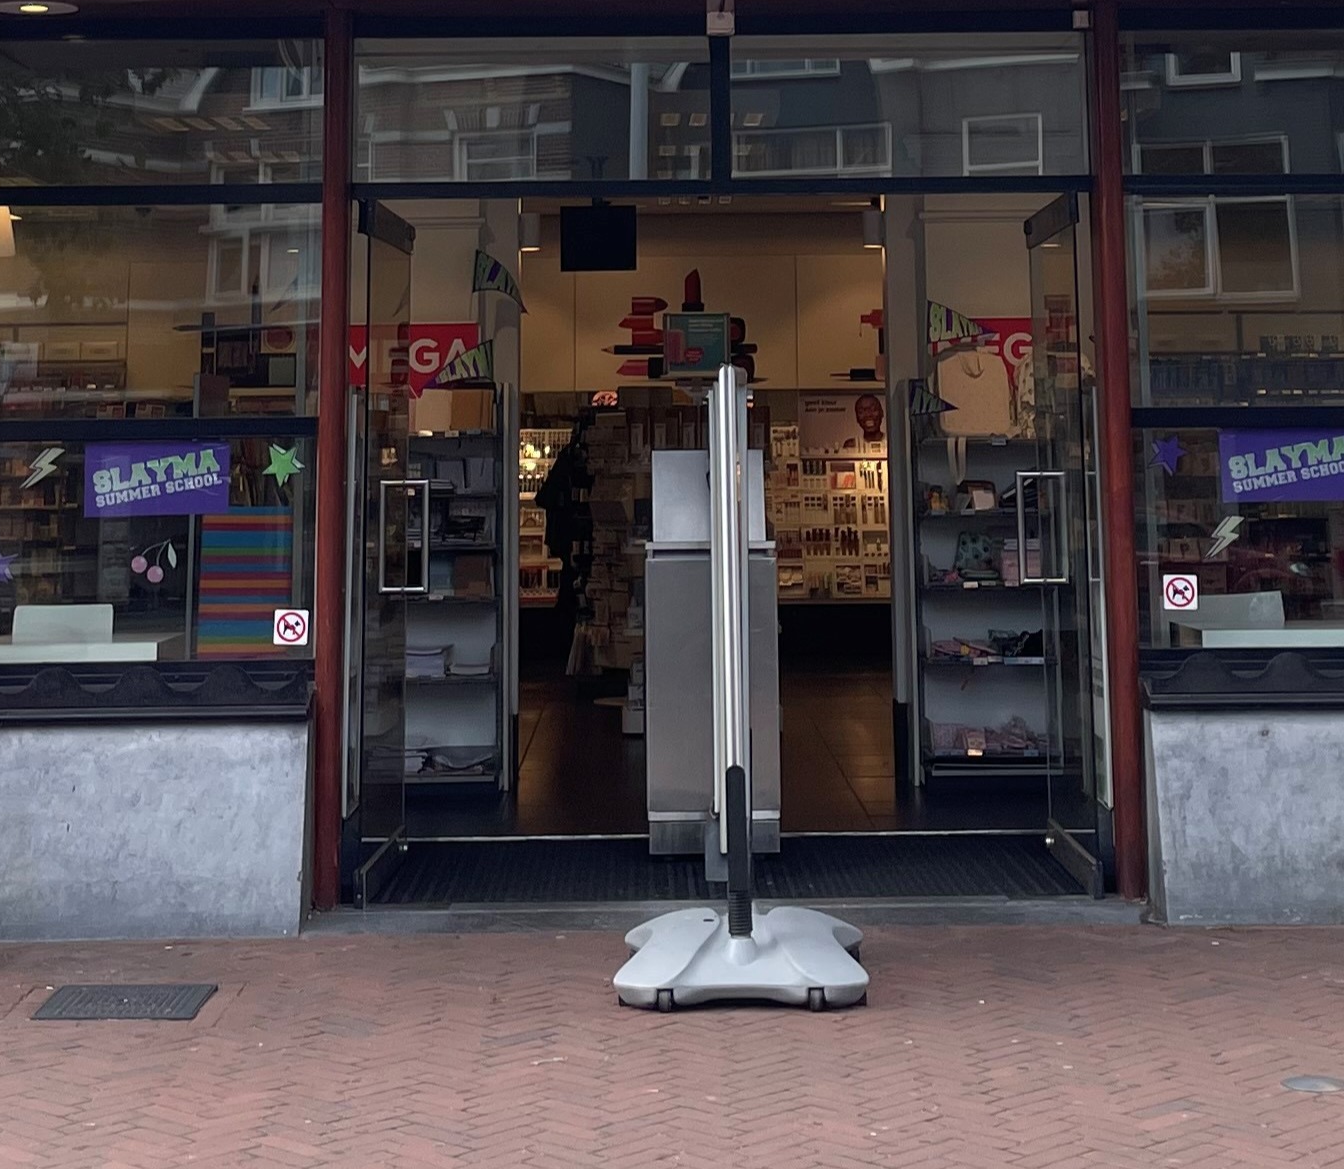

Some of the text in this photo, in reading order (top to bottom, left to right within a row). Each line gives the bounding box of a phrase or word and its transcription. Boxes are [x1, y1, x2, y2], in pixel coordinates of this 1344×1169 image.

[93, 449, 220, 494] SLAYMA
[1232, 470, 1298, 494] SUMMER
[96, 473, 222, 508] SUMMER SCHOOL
